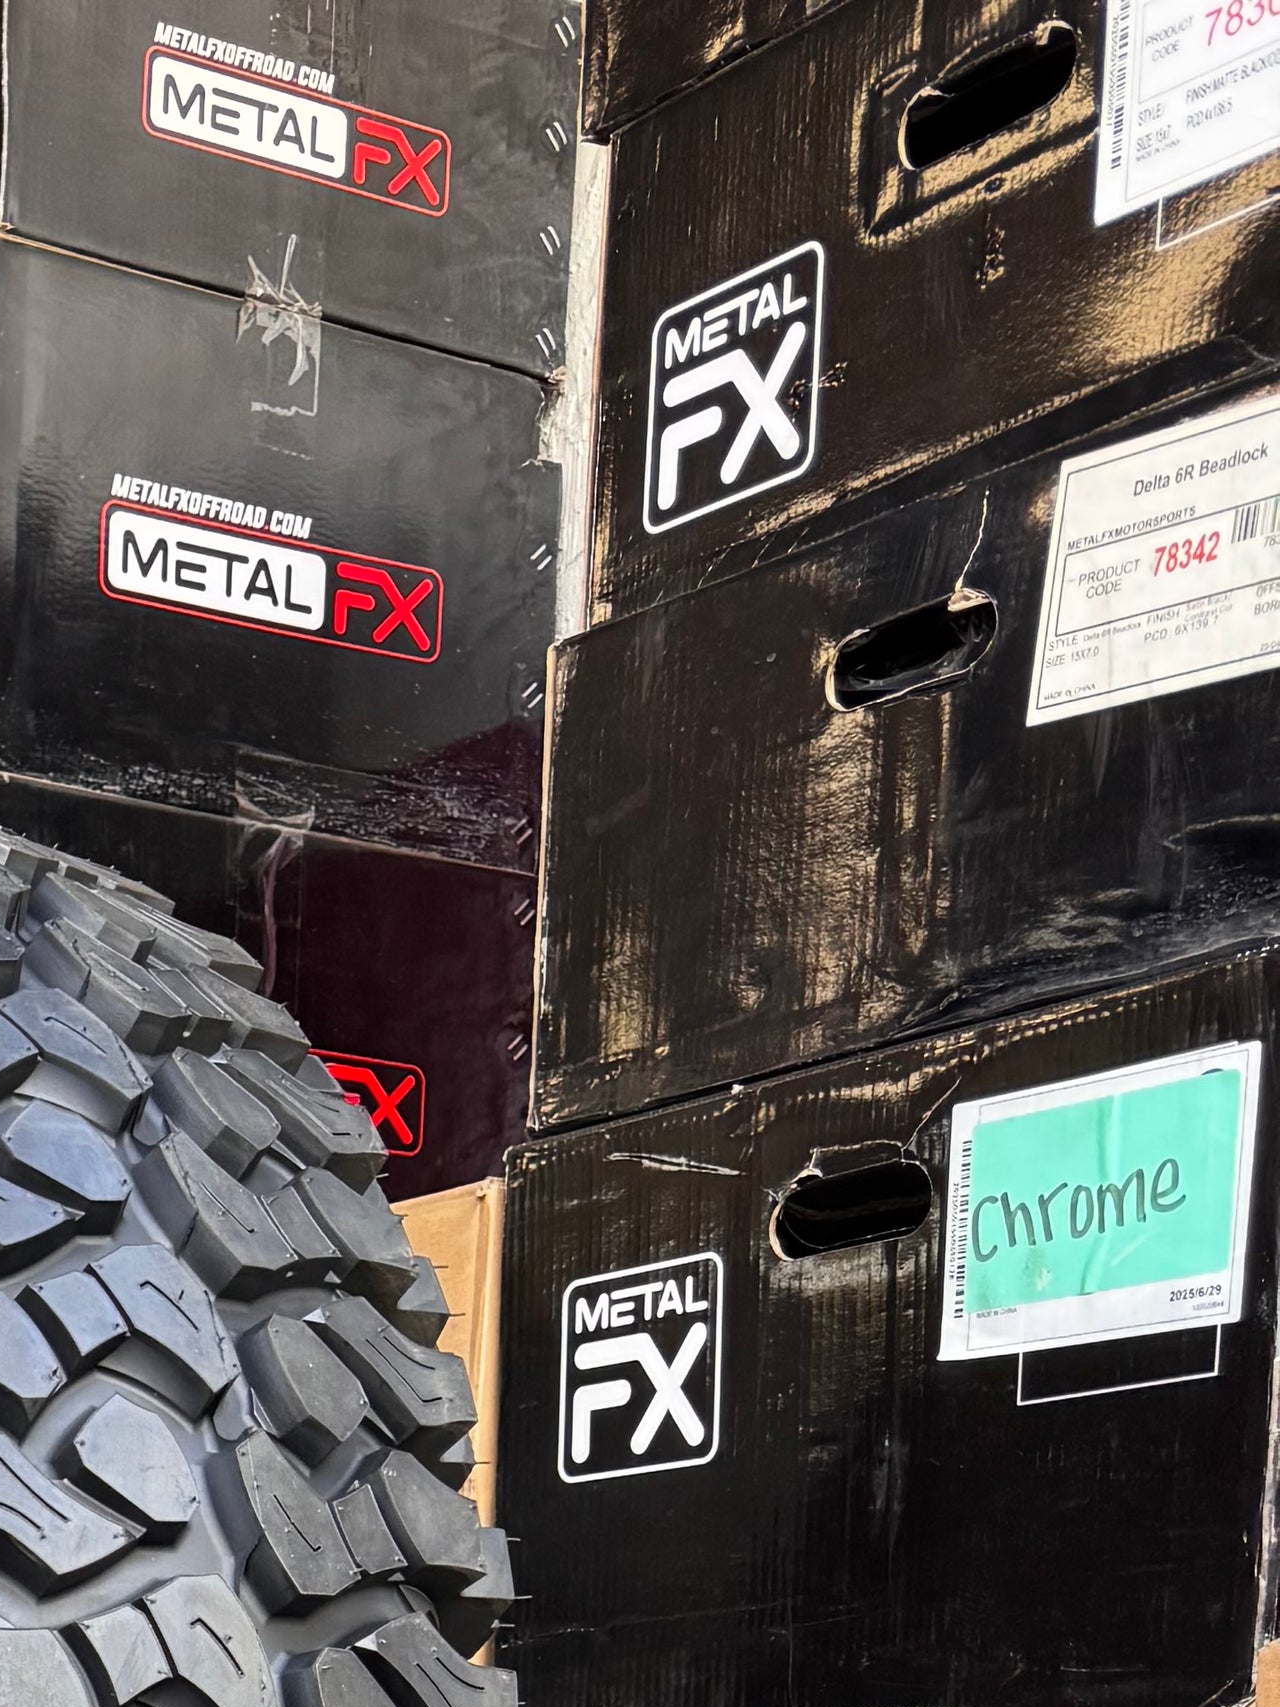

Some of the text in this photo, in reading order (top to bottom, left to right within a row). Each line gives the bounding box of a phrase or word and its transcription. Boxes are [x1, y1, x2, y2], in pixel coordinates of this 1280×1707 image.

[154, 22, 335, 95] METALFXOFFROAD.COM
[162, 74, 442, 207] METAL FX
[665, 273, 808, 370] METAL
[657, 321, 807, 511] FX
[1133, 442, 1270, 498] Delta 6R Beadlock
[111, 473, 313, 540] METALFXOFFROAD.COM
[1067, 505, 1197, 551] METALFXMOTORSPORTS
[1078, 558, 1142, 586] PRODUCT
[1152, 530, 1221, 577] 78342
[122, 529, 433, 652] METAL FX
[1086, 579, 1124, 600] CODE
[971, 1156, 1187, 1265] Chrome
[574, 1275, 710, 1336] METAL
[1169, 1284, 1222, 1302] 2025/6/29
[572, 1321, 708, 1464] FX
